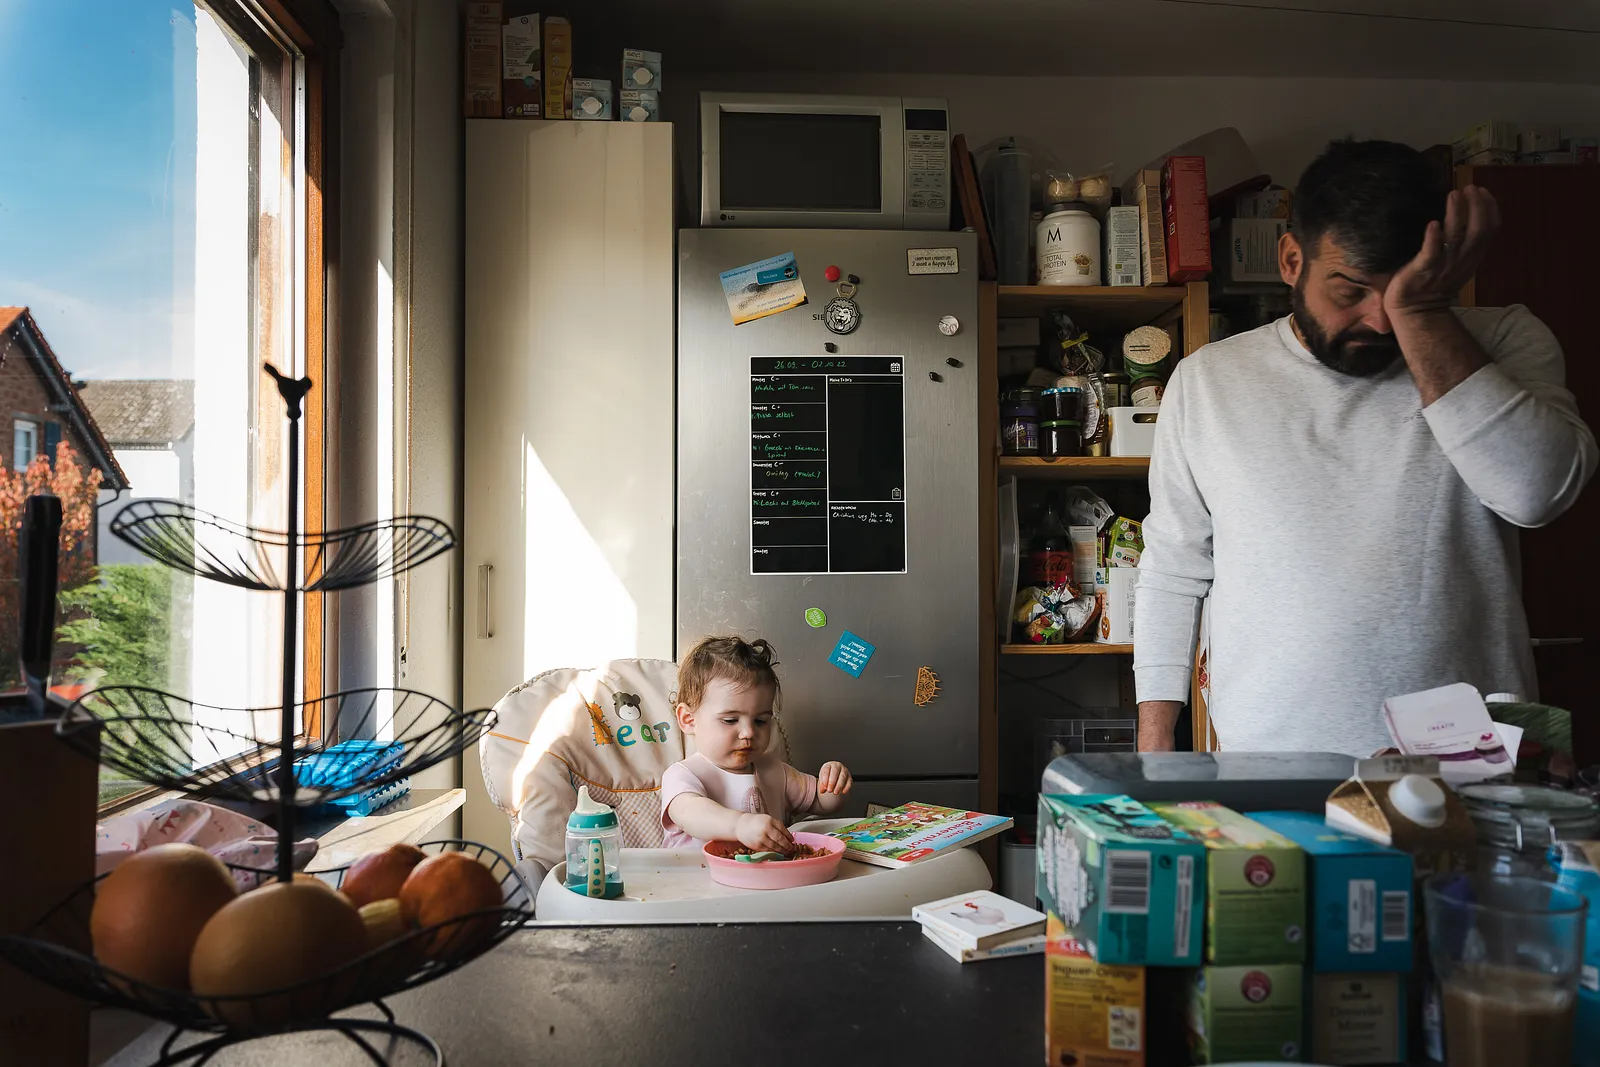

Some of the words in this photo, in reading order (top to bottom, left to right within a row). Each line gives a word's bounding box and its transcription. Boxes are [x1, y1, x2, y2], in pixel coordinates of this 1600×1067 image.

[1046, 227, 1062, 243] M
[1046, 254, 1063, 262] TOTAL
[1043, 260, 1067, 270] PROTEIN
[966, 822, 982, 831] Auf
[906, 820, 974, 849] Bauernhof
[944, 829, 964, 839] dem
